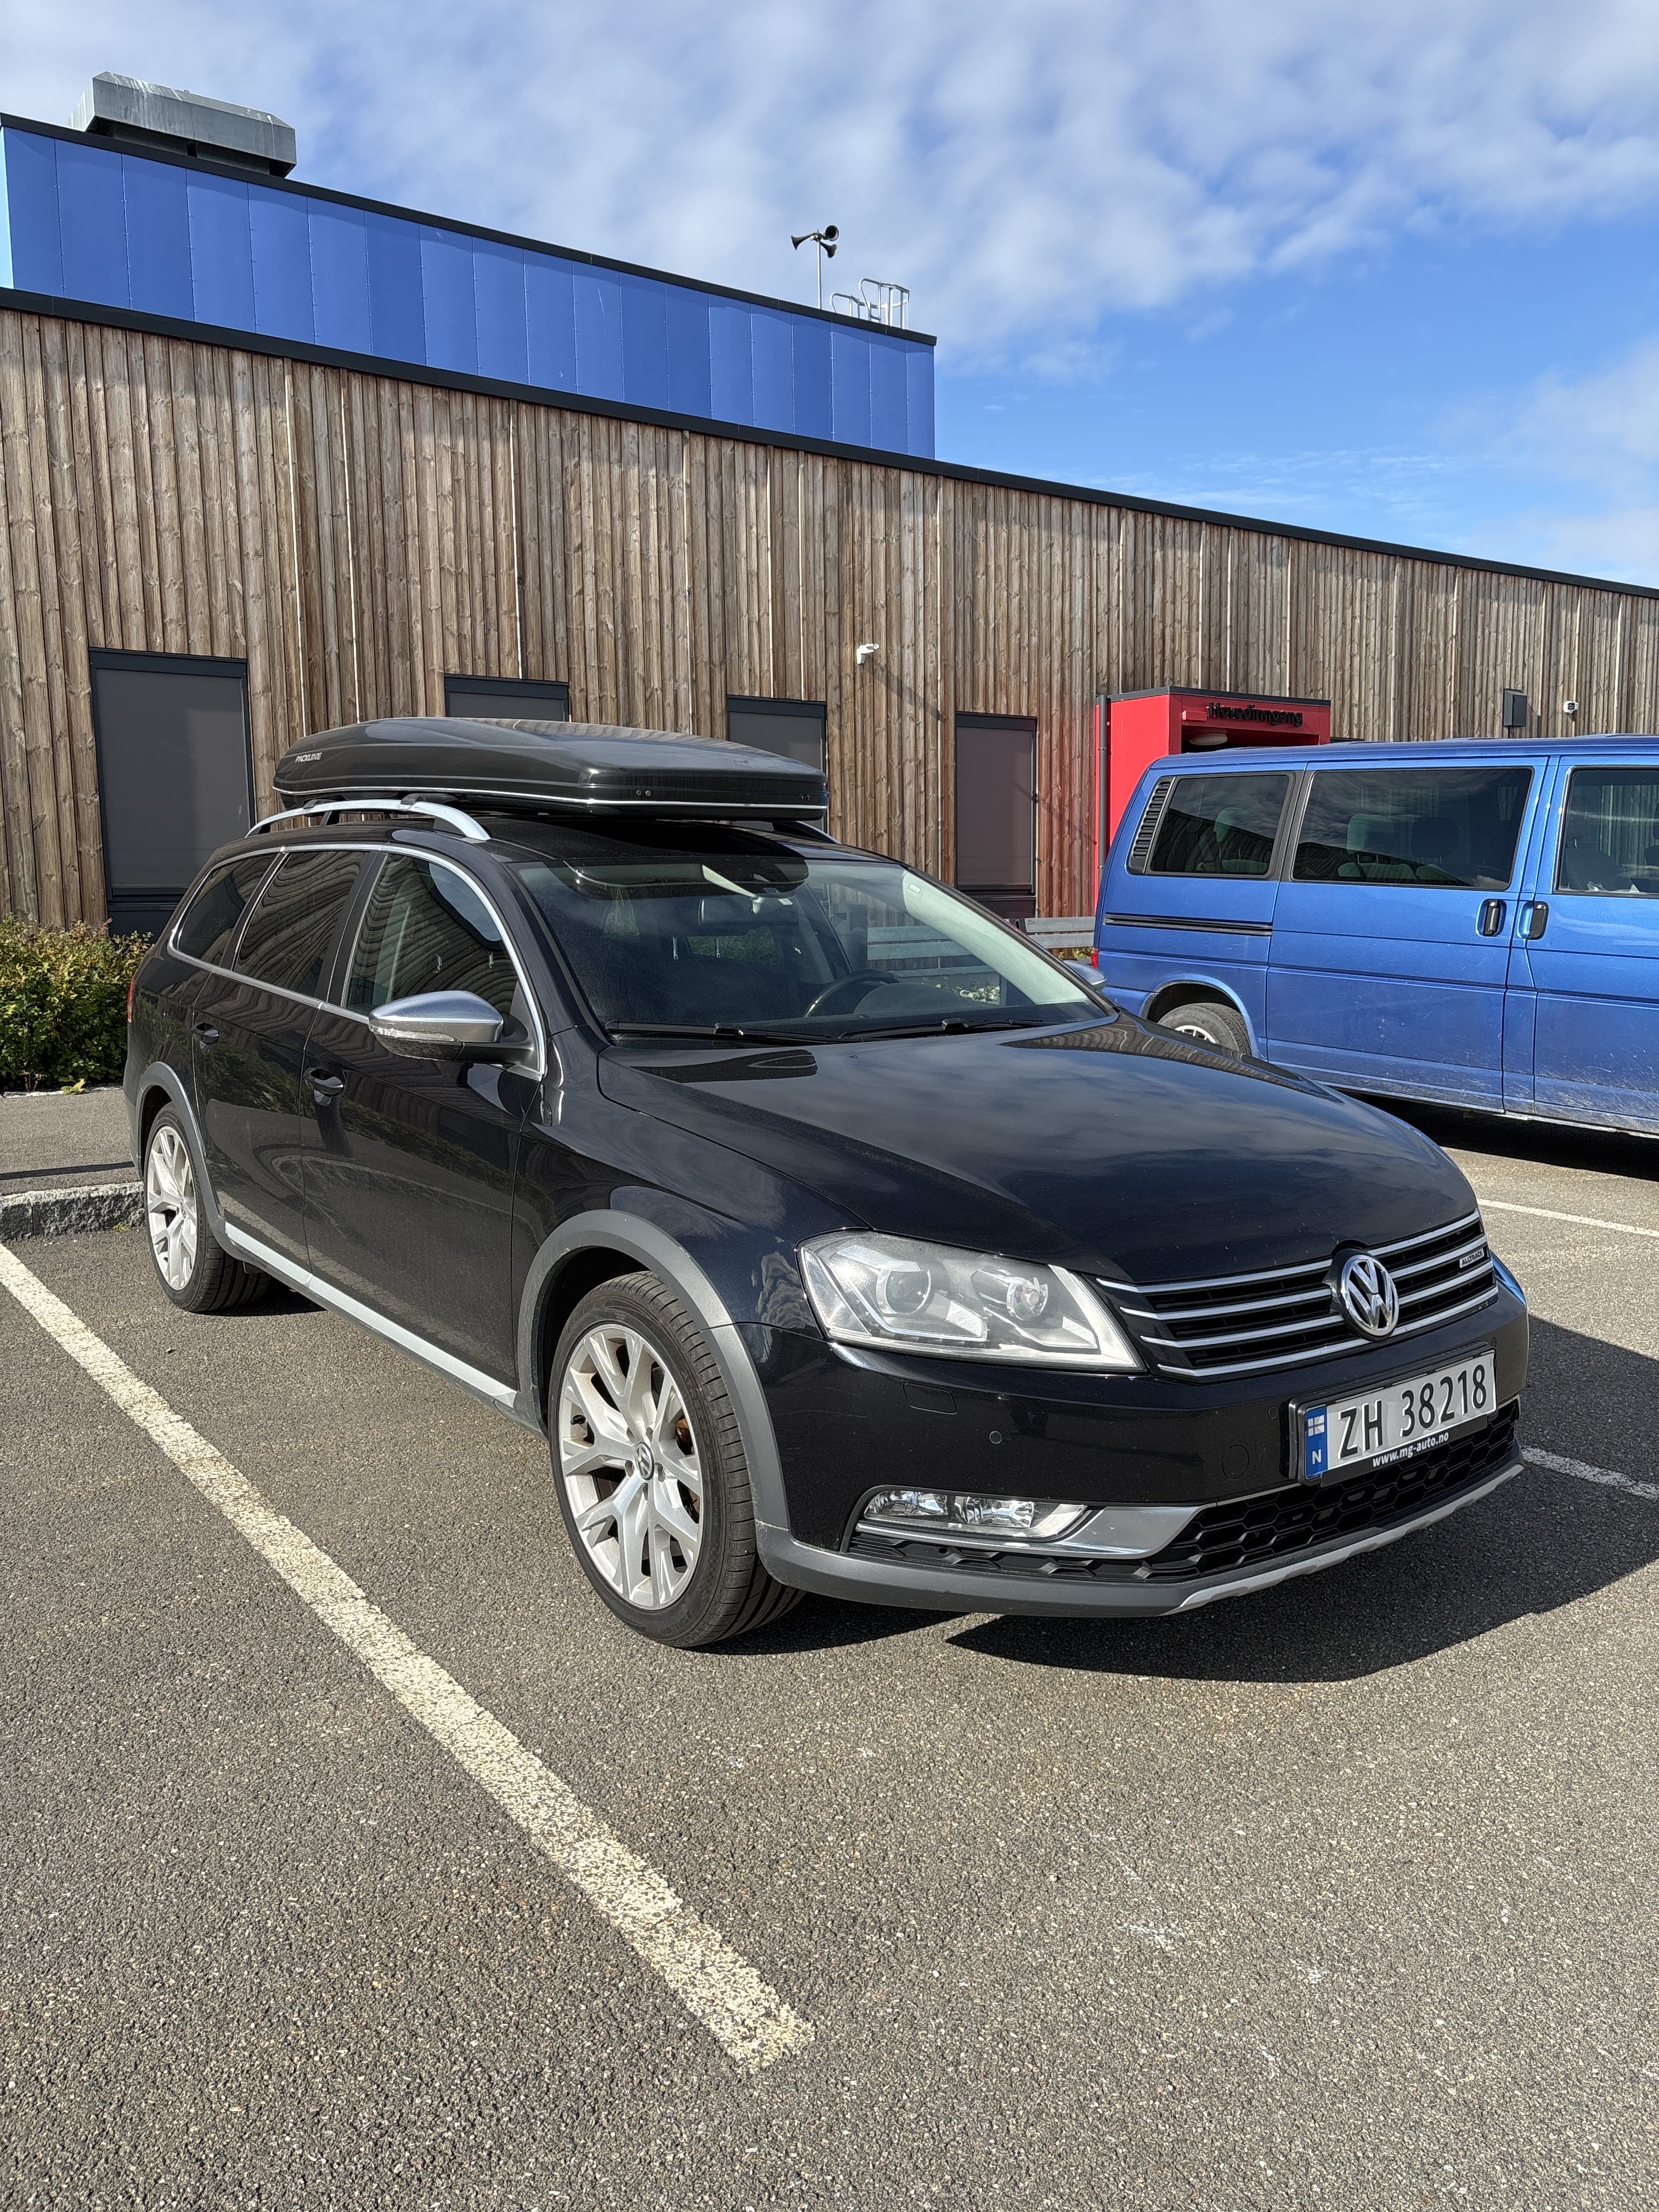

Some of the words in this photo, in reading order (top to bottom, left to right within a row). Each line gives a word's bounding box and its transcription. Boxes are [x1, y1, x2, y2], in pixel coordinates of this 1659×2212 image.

[1207, 702, 1303, 727] Hovedinngang
[295, 752, 323, 764] PACKLINE
[1461, 1249, 1484, 1266] ALLTRACK
[1338, 1398, 1383, 1460] ZH
[1400, 1364, 1487, 1438] 38218
[1311, 1448, 1322, 1465] N
[1372, 1431, 1450, 1468] www.mg-auto.no
